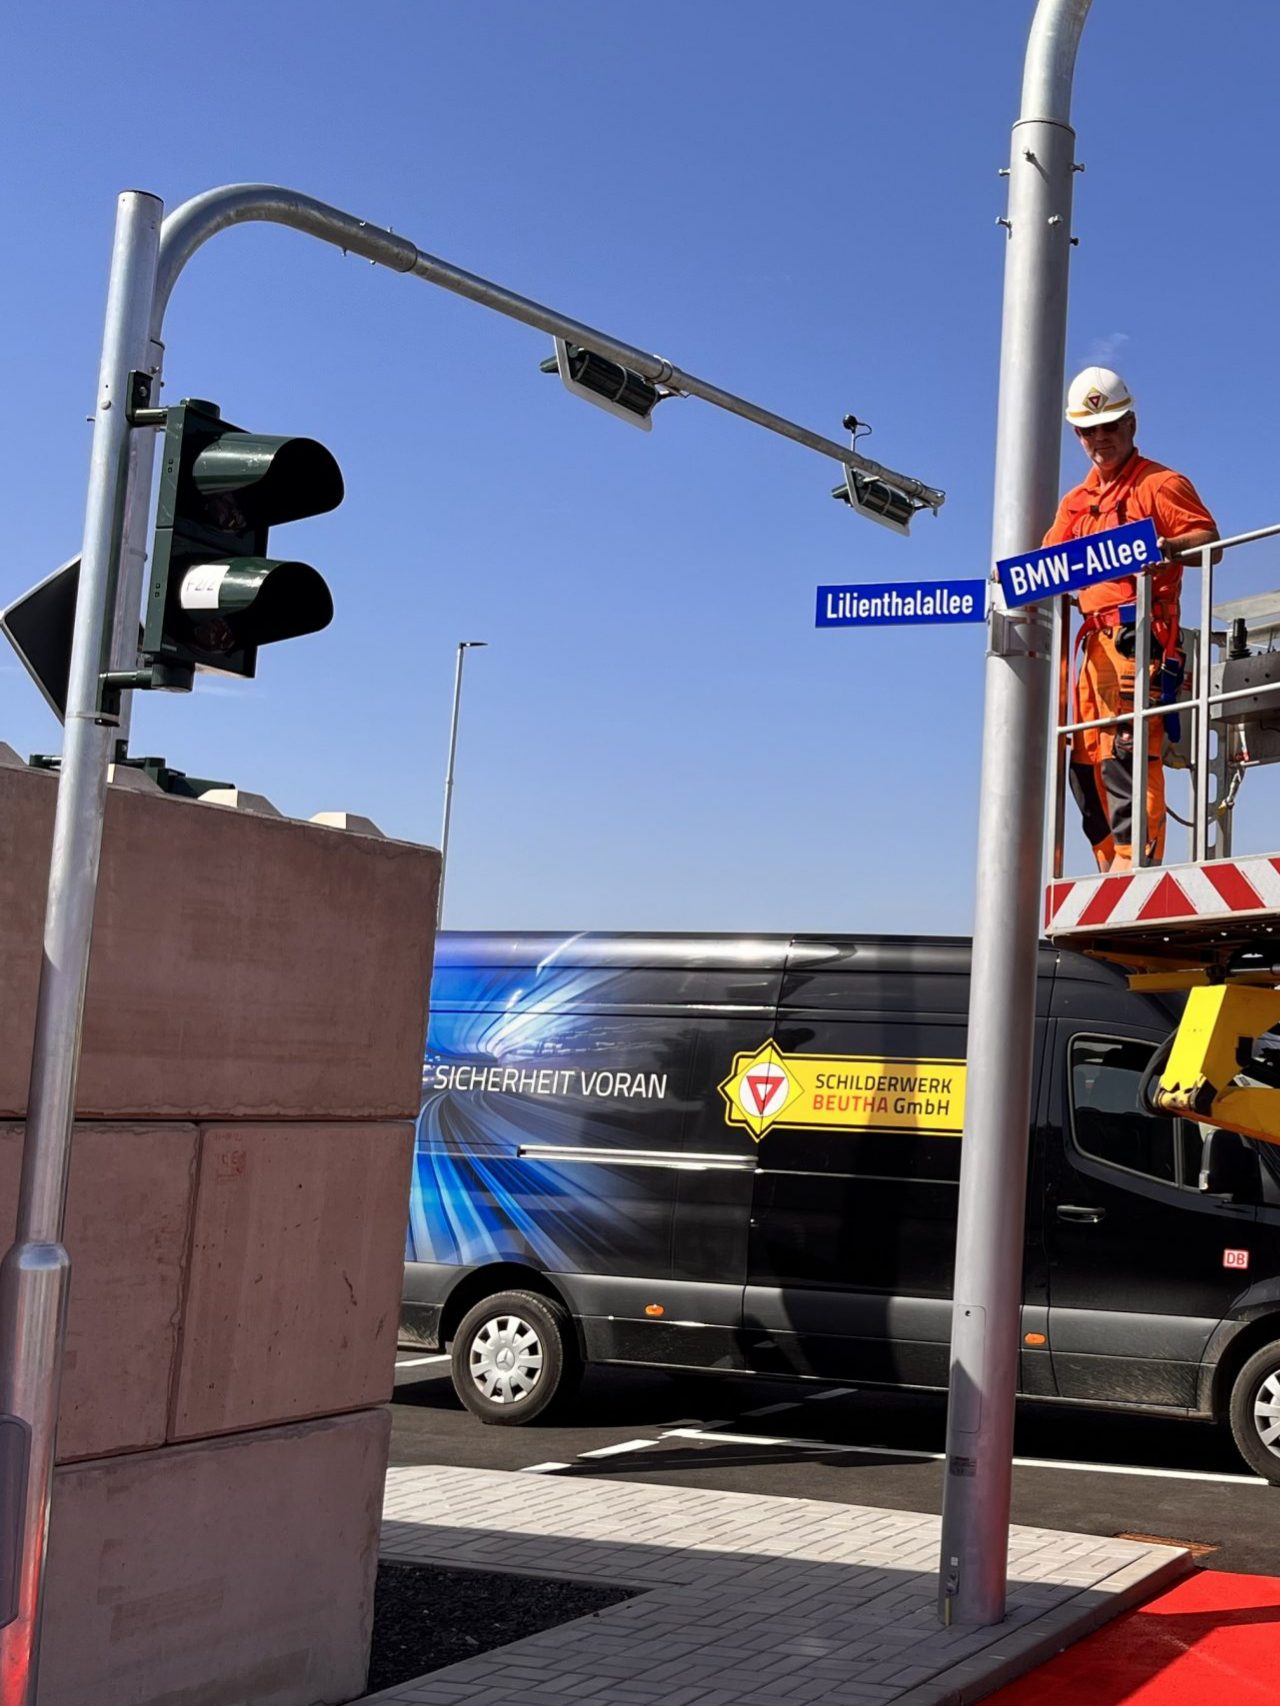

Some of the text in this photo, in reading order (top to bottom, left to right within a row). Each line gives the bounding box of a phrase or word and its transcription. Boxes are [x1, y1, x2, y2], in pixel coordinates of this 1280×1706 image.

[1010, 537, 1148, 596] BMW-Allee
[825, 589, 974, 619] Lilienthalallee
[434, 1064, 575, 1095] SICHERHEIT
[580, 1071, 668, 1099] VORAN
[815, 1073, 952, 1094] SCHILDERWERK
[813, 1094, 950, 1116] BEUTHA GmbH
[1226, 1252, 1246, 1266] DB
